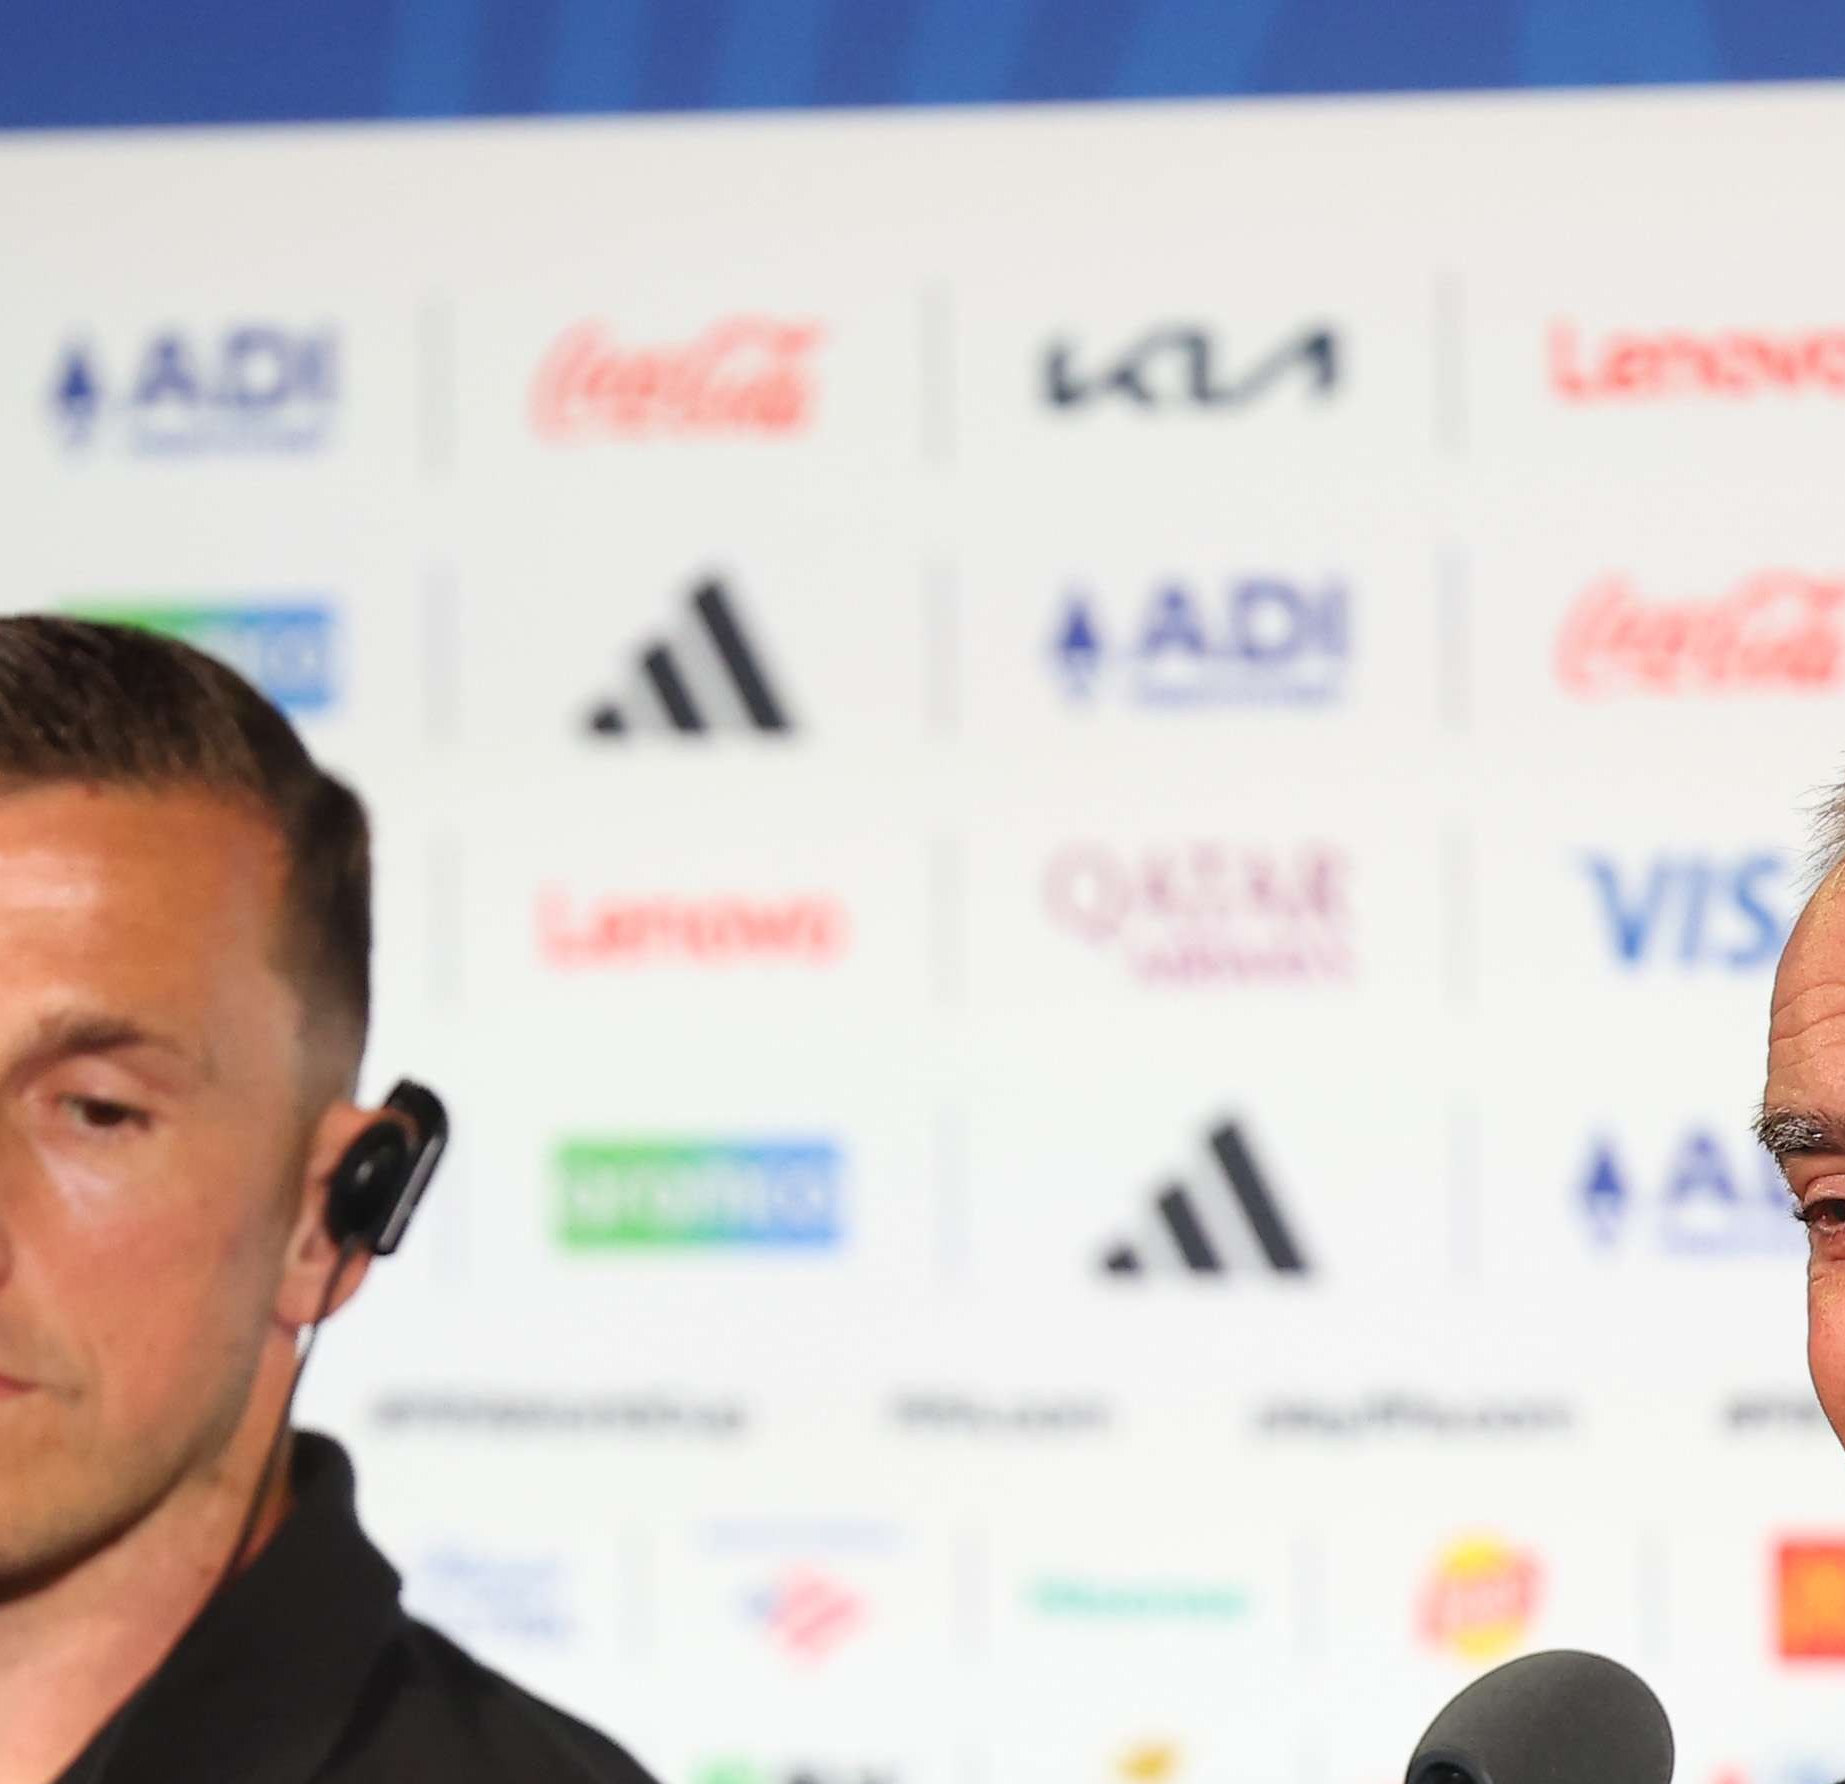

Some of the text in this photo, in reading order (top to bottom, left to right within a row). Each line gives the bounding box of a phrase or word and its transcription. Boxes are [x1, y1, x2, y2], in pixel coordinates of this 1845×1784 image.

[124, 325, 338, 404] ADI
[1132, 575, 1350, 664] ADI
[540, 888, 848, 967] Lenovo
[1584, 853, 1784, 970] VIS
